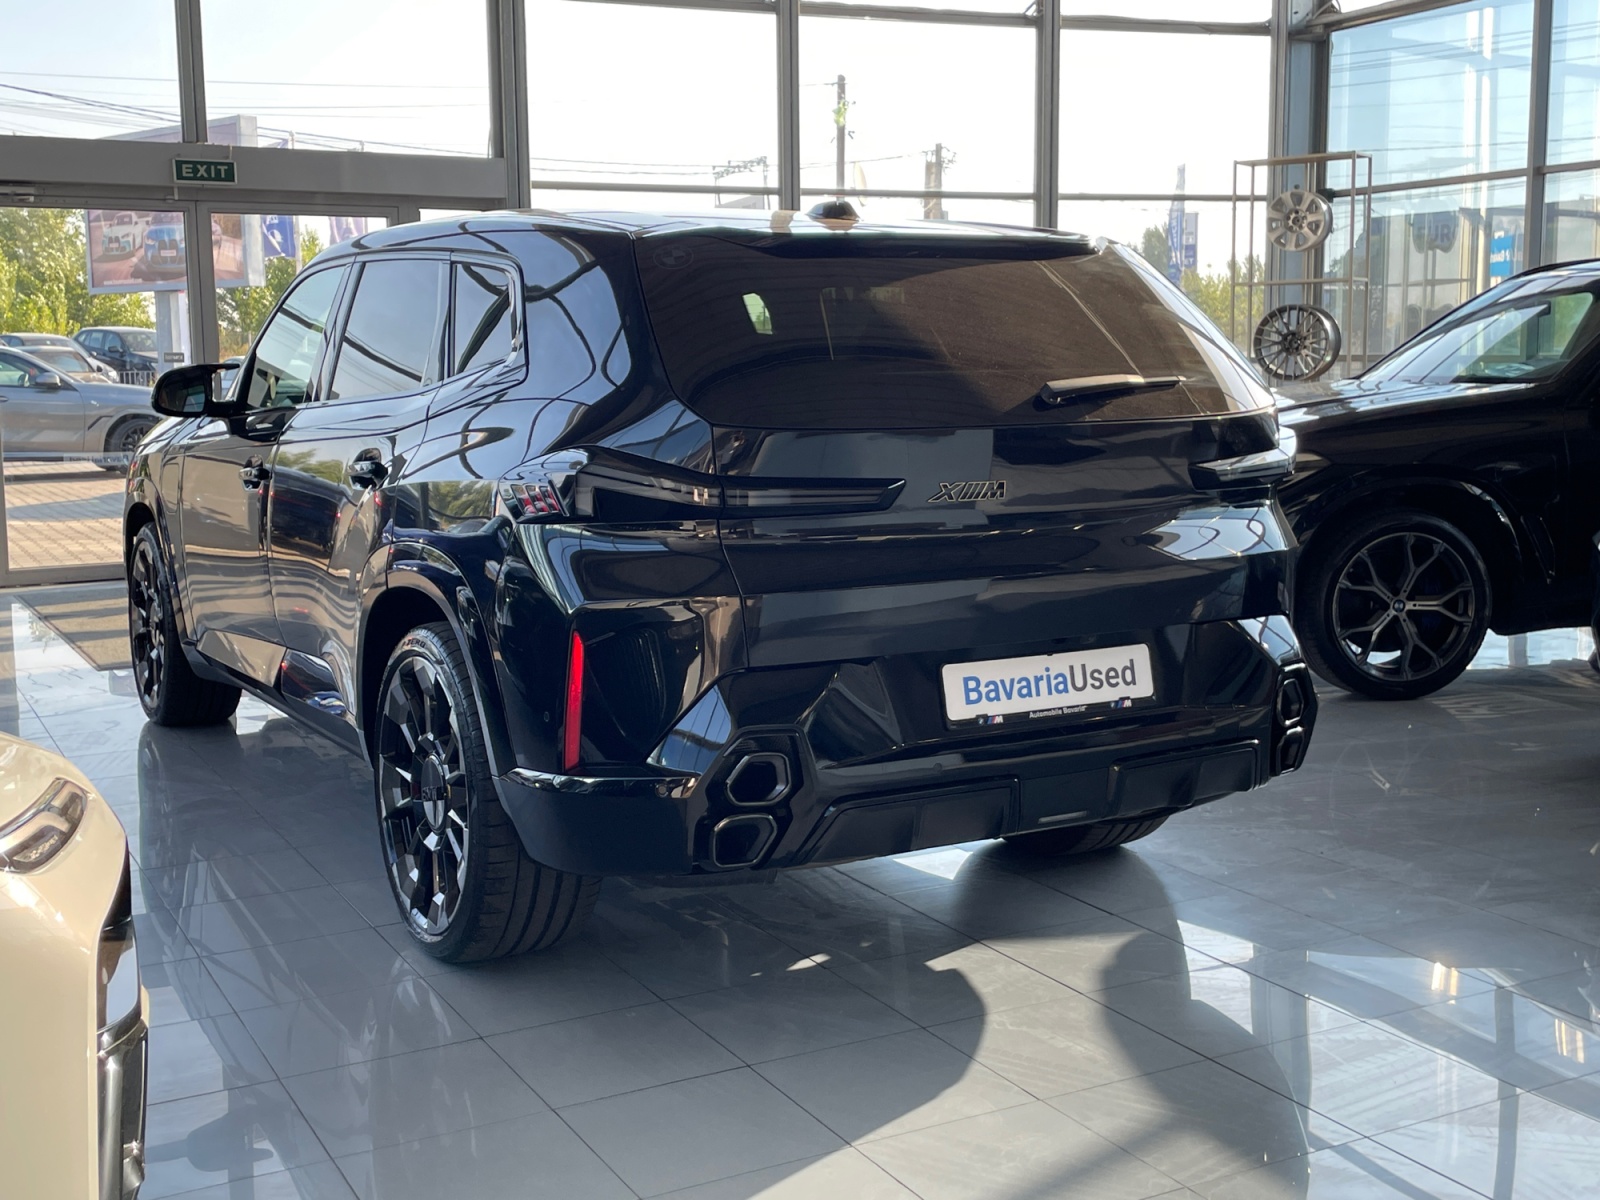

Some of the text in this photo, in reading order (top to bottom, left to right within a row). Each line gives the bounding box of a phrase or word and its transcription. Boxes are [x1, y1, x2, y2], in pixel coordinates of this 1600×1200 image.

[181, 164, 229, 178] EXIT
[962, 658, 1137, 706] BavariaUsed
[1029, 705, 1086, 719] Automobile Bavaria
